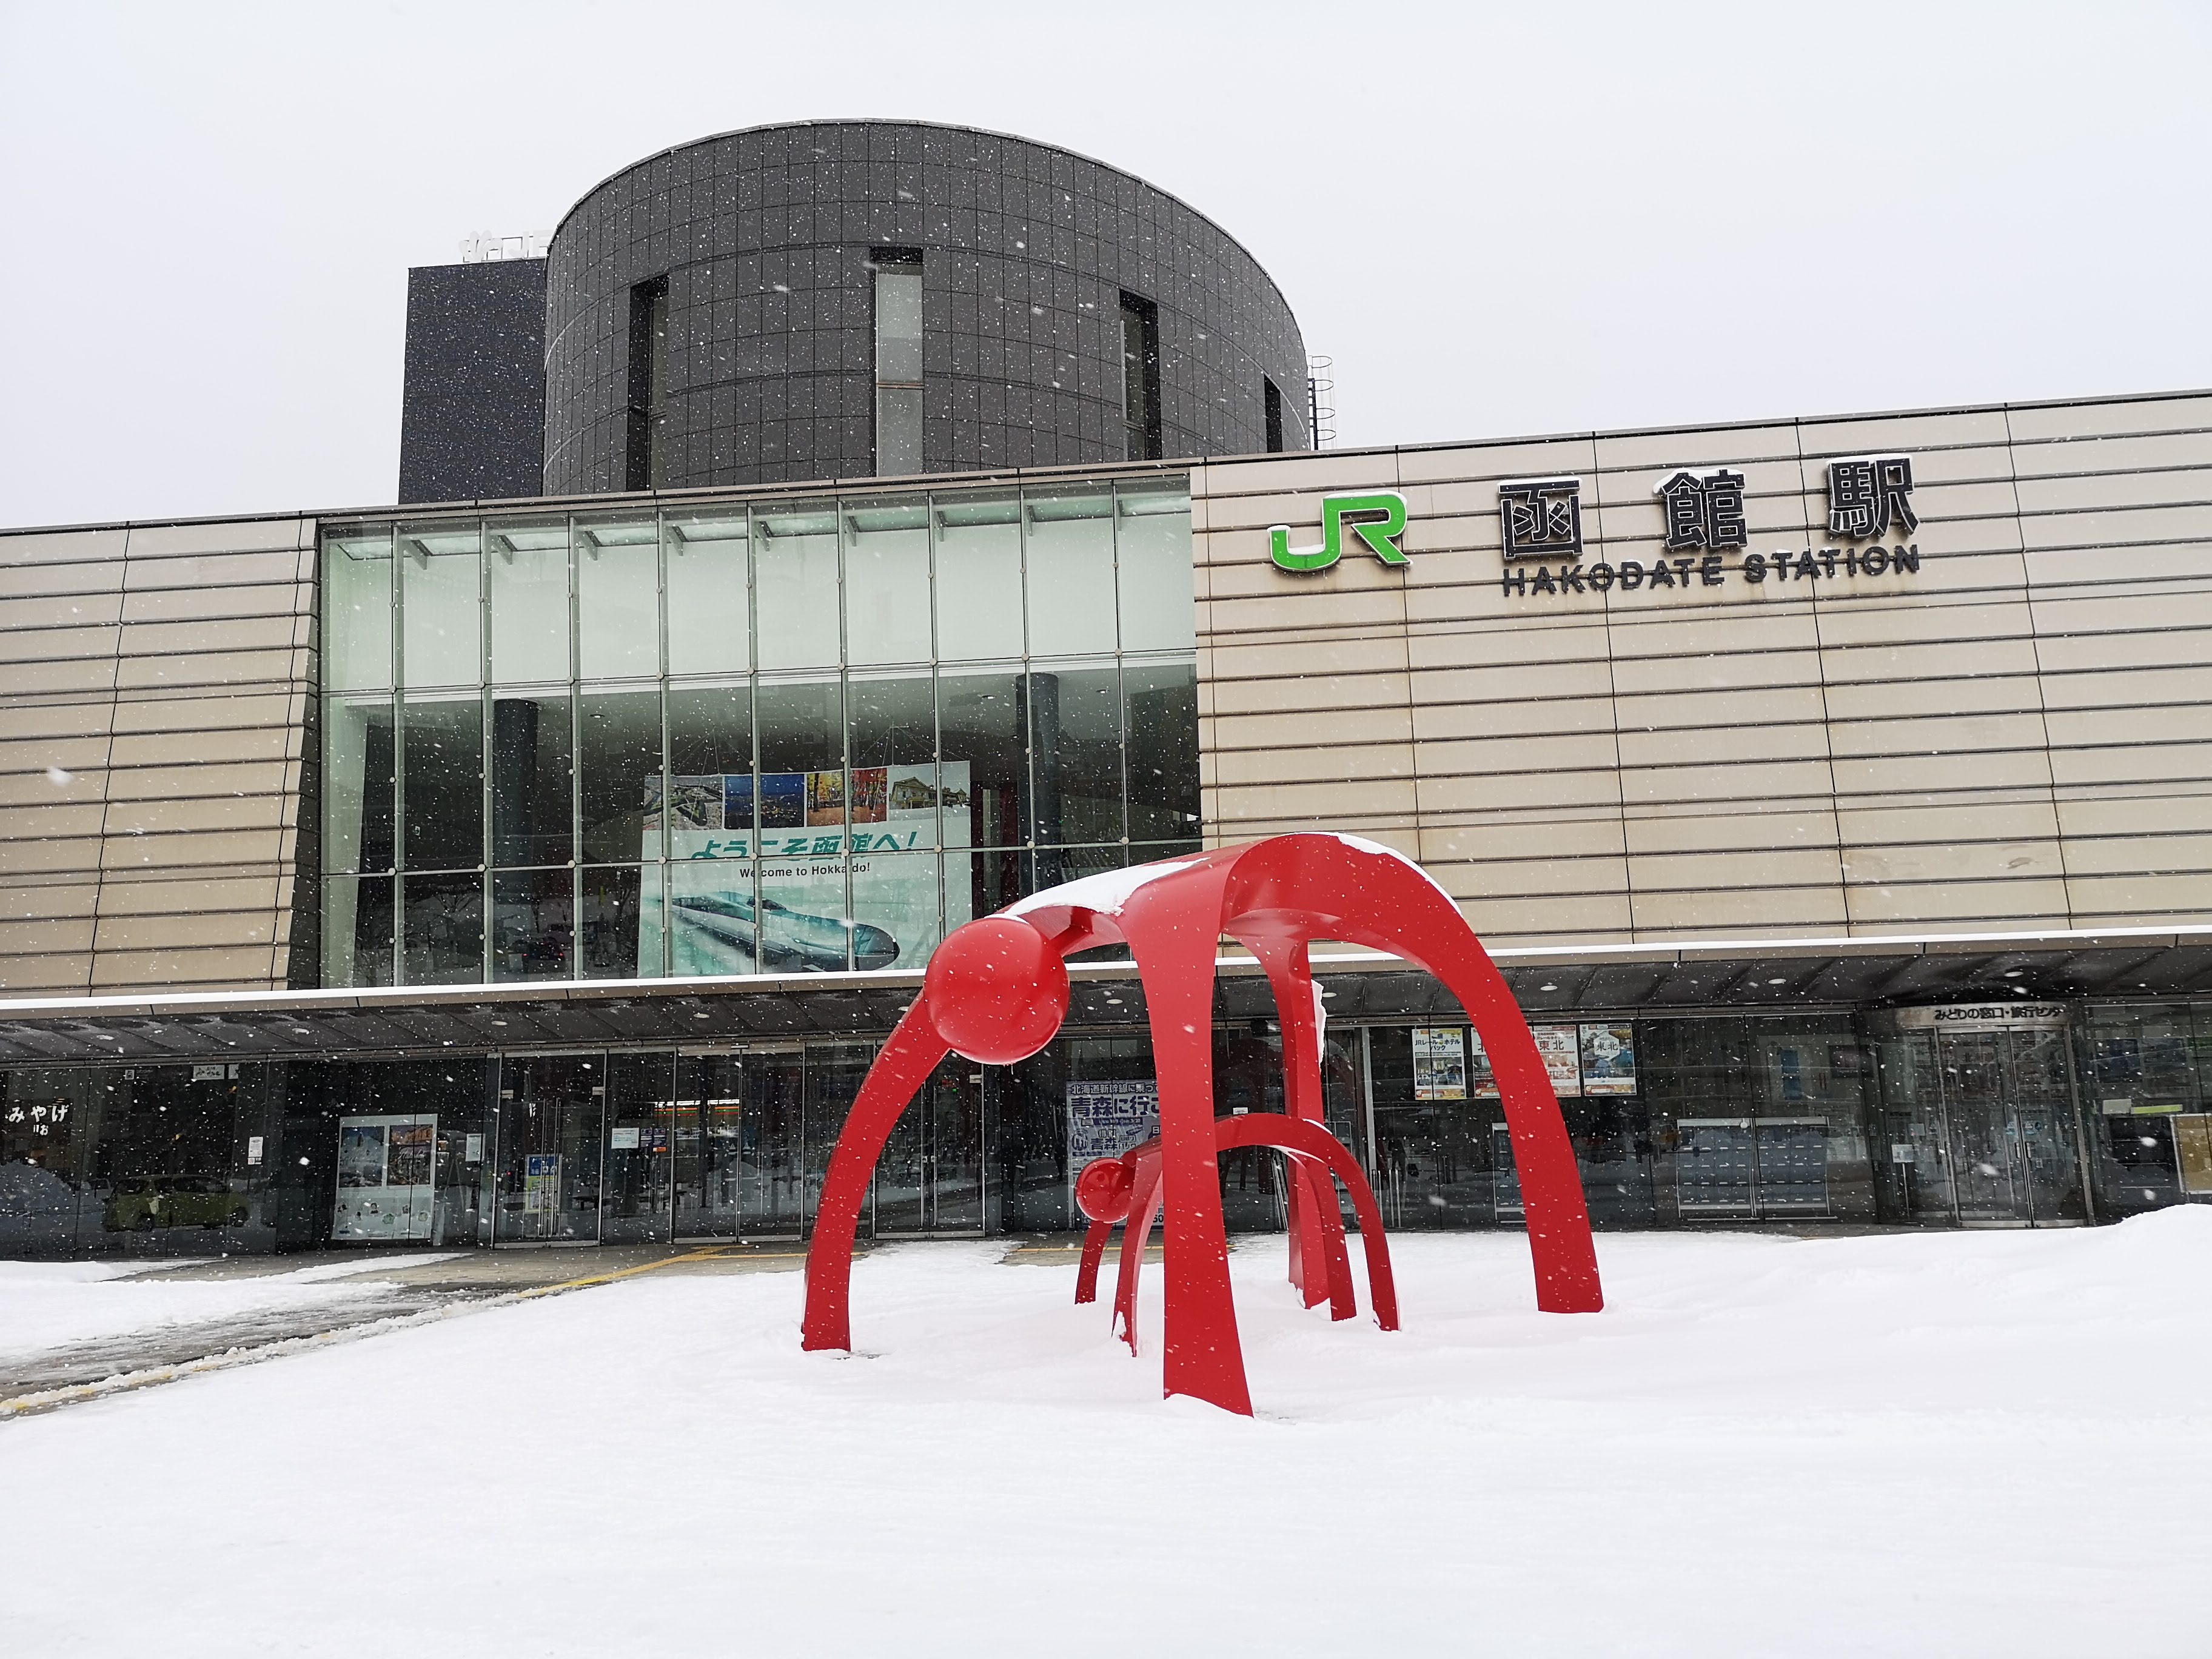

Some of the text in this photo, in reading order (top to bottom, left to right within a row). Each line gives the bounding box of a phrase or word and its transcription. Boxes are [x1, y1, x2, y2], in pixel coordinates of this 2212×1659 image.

[1499, 457, 1920, 558] 函館駅
[1269, 494, 1410, 572] JR
[1503, 544, 1920, 596] HAKODATE STATION
[740, 862, 871, 878] Wecome to Hokkado!
[1539, 1040, 1564, 1051] 東北
[8, 1104, 69, 1123] みやげ
